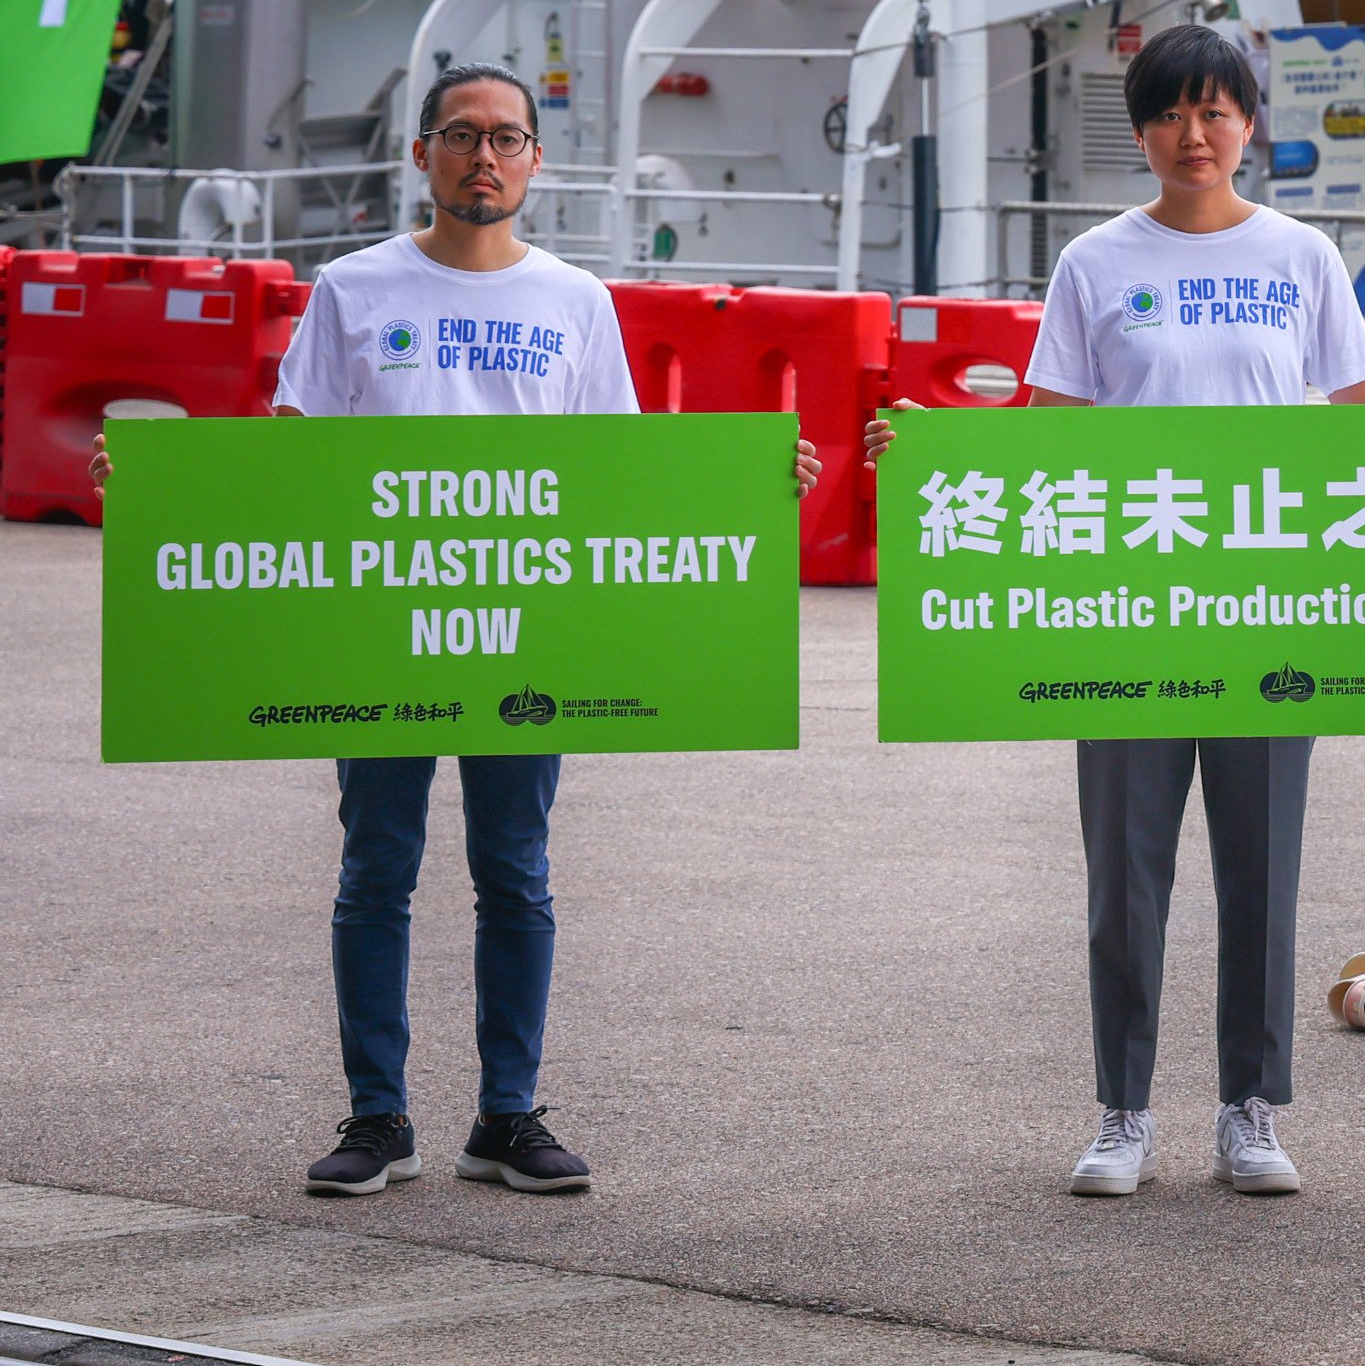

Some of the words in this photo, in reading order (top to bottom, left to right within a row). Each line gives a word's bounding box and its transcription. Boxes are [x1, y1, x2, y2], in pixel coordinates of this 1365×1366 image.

[1178, 278, 1216, 300] END
[1224, 277, 1259, 300] THE
[1266, 279, 1300, 309] AGE
[1179, 302, 1203, 326] OF
[1211, 302, 1287, 330] PLASTIC
[438, 318, 477, 344] END
[485, 320, 523, 345] THE
[528, 326, 565, 356] AGE
[438, 345, 461, 369] OF
[468, 347, 549, 377] PLASTIC
[372, 469, 558, 517] STRONG
[157, 542, 333, 589] GLOBAL
[352, 538, 571, 586] PLASTICS
[586, 536, 756, 583] TREATY
[922, 589, 993, 630] Cut
[1009, 586, 1154, 628] Plastic
[412, 608, 521, 655] NOW
[1019, 681, 1153, 703] GREENPEACE
[1158, 679, 1226, 699] 綠色和平
[1321, 687, 1333, 695] THE
[1351, 677, 1365, 685] FOR
[248, 704, 388, 727] GREENPEACE
[393, 702, 464, 722] 綠色和平
[562, 700, 591, 708] SAILING
[593, 699, 608, 707] FOR
[610, 699, 642, 707] CHANGE:
[562, 710, 576, 718] THE
[578, 709, 628, 717] PLASTIC-FREE
[630, 708, 658, 716] FUTURE
